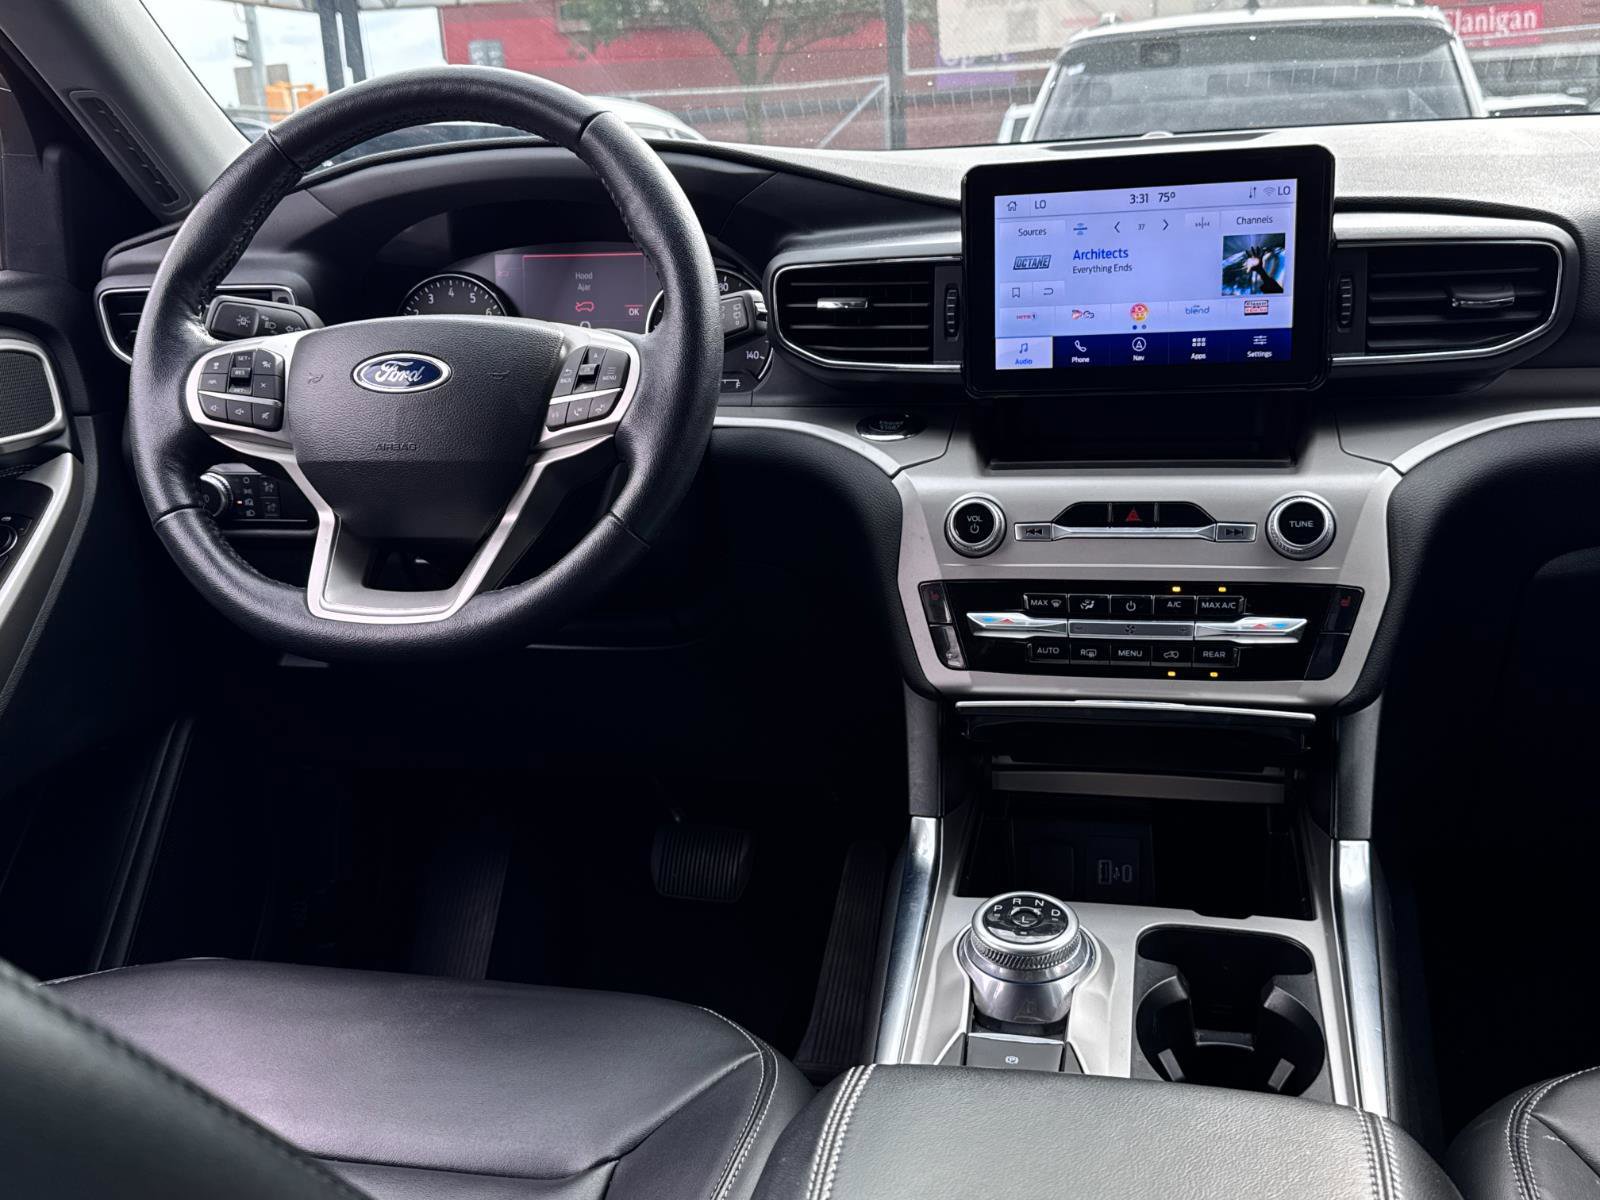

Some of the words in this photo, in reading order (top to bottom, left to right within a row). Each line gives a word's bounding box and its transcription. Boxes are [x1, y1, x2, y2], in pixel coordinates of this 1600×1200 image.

[1277, 185, 1291, 196] LO
[1129, 193, 1150, 205] 3:31
[1034, 199, 1047, 210] LO
[1236, 215, 1273, 225] Channels
[1018, 227, 1047, 237] Sources
[1072, 247, 1129, 261] Architects
[1015, 256, 1050, 269] OCTANE
[1072, 264, 1112, 275] Everything
[1113, 263, 1133, 273] Ends
[575, 271, 593, 280] Hood
[577, 283, 591, 292] Ajar
[448, 288, 454, 298] 4
[427, 294, 434, 304] 3
[469, 293, 476, 303] 5
[628, 308, 640, 316] OK
[745, 350, 760, 360] 140
[1132, 353, 1145, 362] Nav
[1190, 352, 1206, 361] Apps
[1246, 350, 1273, 359] Settings
[1014, 357, 1033, 366] Audio
[1071, 355, 1090, 364] Phone
[375, 360, 423, 383] Ford
[1288, 520, 1314, 528] TUNE
[1030, 599, 1048, 607] MAX
[1166, 600, 1182, 609] A/C
[1201, 601, 1220, 609] MAX
[1220, 601, 1237, 609] A/C
[1118, 649, 1143, 657] MENU
[1202, 650, 1226, 658] REAR
[1012, 897, 1022, 905] R
[1034, 899, 1045, 907] N
[1051, 909, 1061, 917] D
[1021, 915, 1030, 923] L
